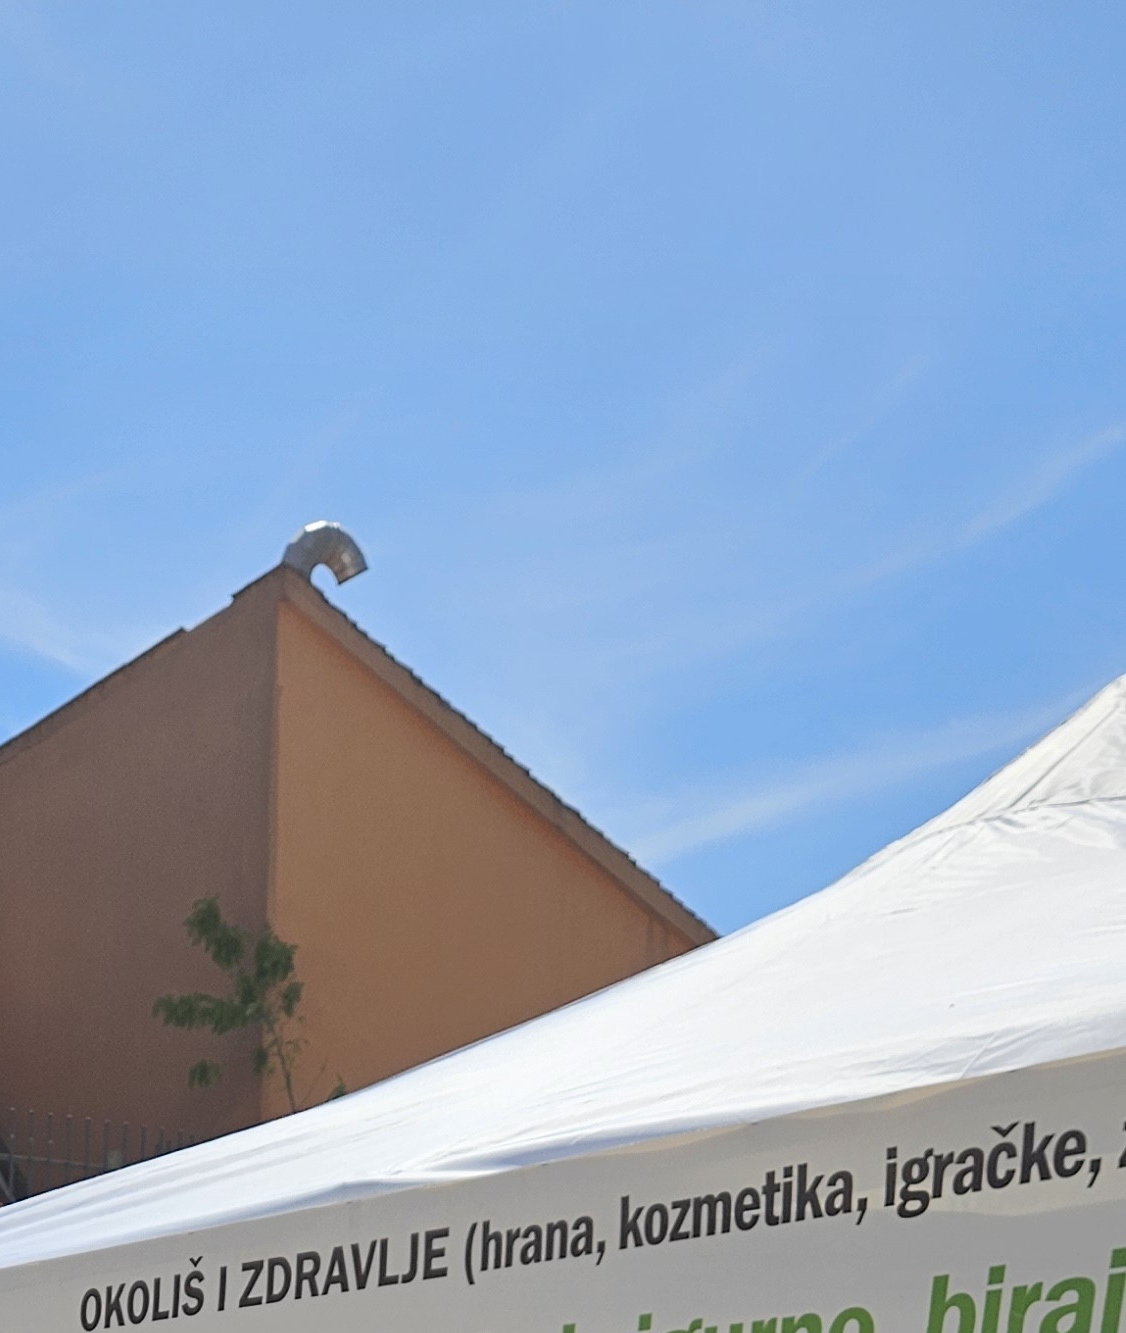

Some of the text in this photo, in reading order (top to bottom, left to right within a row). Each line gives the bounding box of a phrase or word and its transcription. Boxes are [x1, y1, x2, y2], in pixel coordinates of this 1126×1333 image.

[80, 1255, 205, 1332] OKOLIŠ
[217, 1266, 227, 1312] I
[238, 1227, 450, 1309] ZDRAVLJE
[464, 1215, 606, 1285] (hrana,
[618, 1162, 868, 1250] kozmetika,
[884, 1120, 1102, 1219] igračke,
